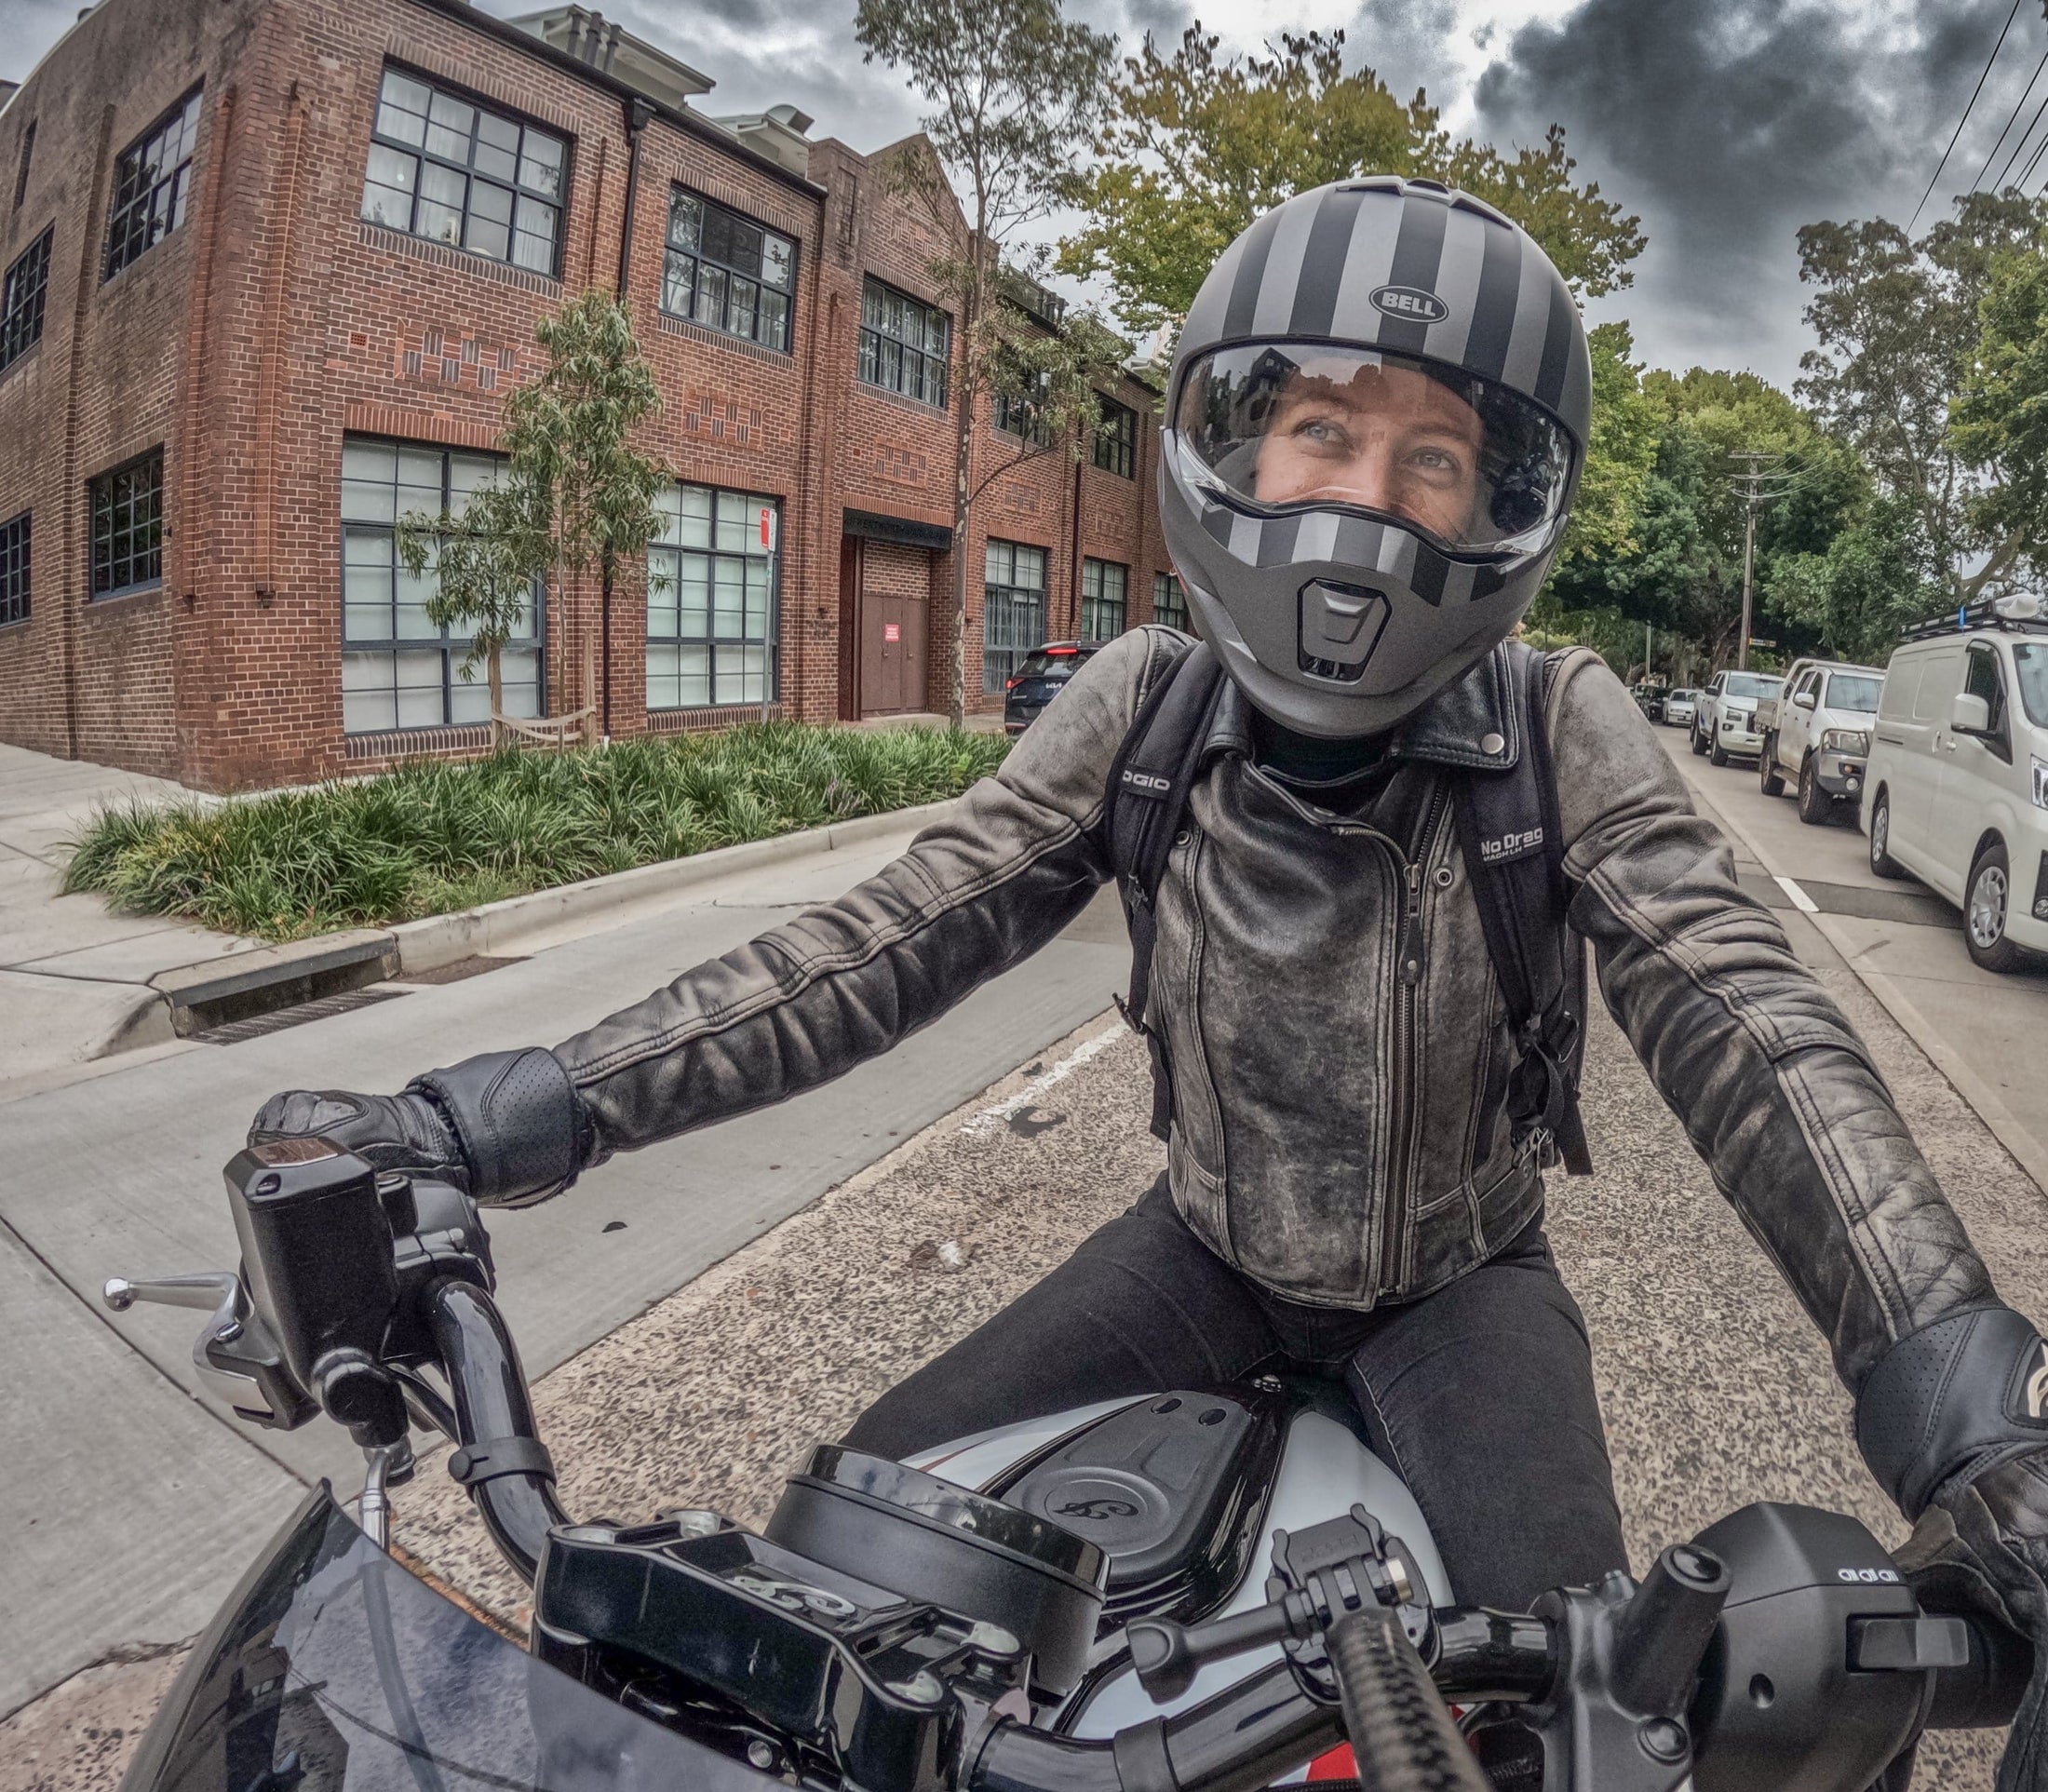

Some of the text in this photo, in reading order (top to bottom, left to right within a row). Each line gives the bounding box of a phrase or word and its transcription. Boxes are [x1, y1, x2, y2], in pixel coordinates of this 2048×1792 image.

[1381, 291, 1435, 317] BELL
[1481, 827, 1543, 856] No Drag
